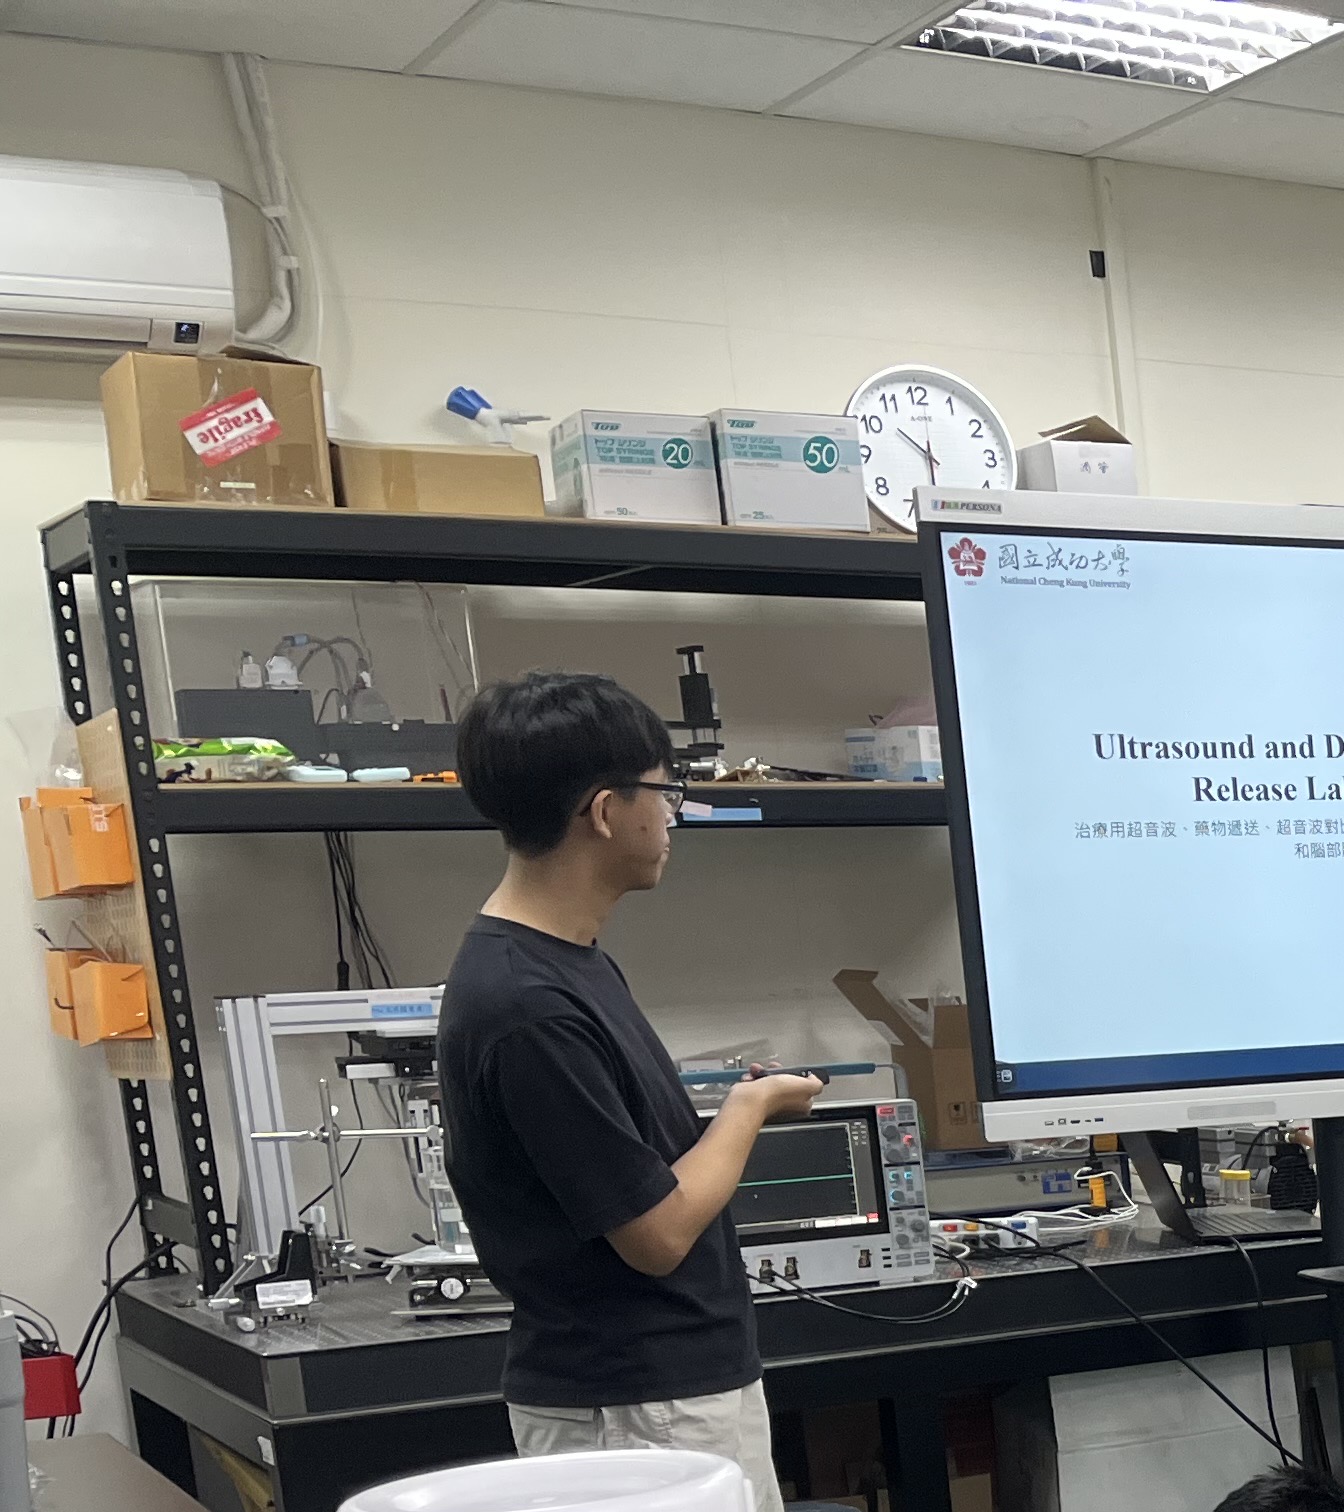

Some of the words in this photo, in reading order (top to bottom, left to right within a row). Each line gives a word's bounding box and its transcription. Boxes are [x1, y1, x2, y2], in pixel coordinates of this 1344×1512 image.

[879, 393, 898, 413] 11
[905, 386, 928, 406] 12
[945, 396, 954, 415] 1
[196, 407, 264, 444] fragile
[860, 415, 883, 434] 10
[968, 419, 983, 438] 2
[664, 443, 692, 464] 20
[805, 443, 837, 467] 50
[860, 444, 872, 464] 9
[983, 450, 997, 468] 3
[875, 477, 889, 496] 8
[616, 507, 628, 516] 50
[752, 511, 765, 520] 25
[998, 541, 1130, 577] 國立成功大學
[1000, 576, 1037, 586] National
[1038, 577, 1064, 588] Cheng
[1066, 578, 1088, 589] Kung
[1089, 579, 1131, 590] University
[1093, 733, 1255, 760] Ultrasound
[1264, 734, 1316, 760] and
[1192, 776, 1298, 802] Release
